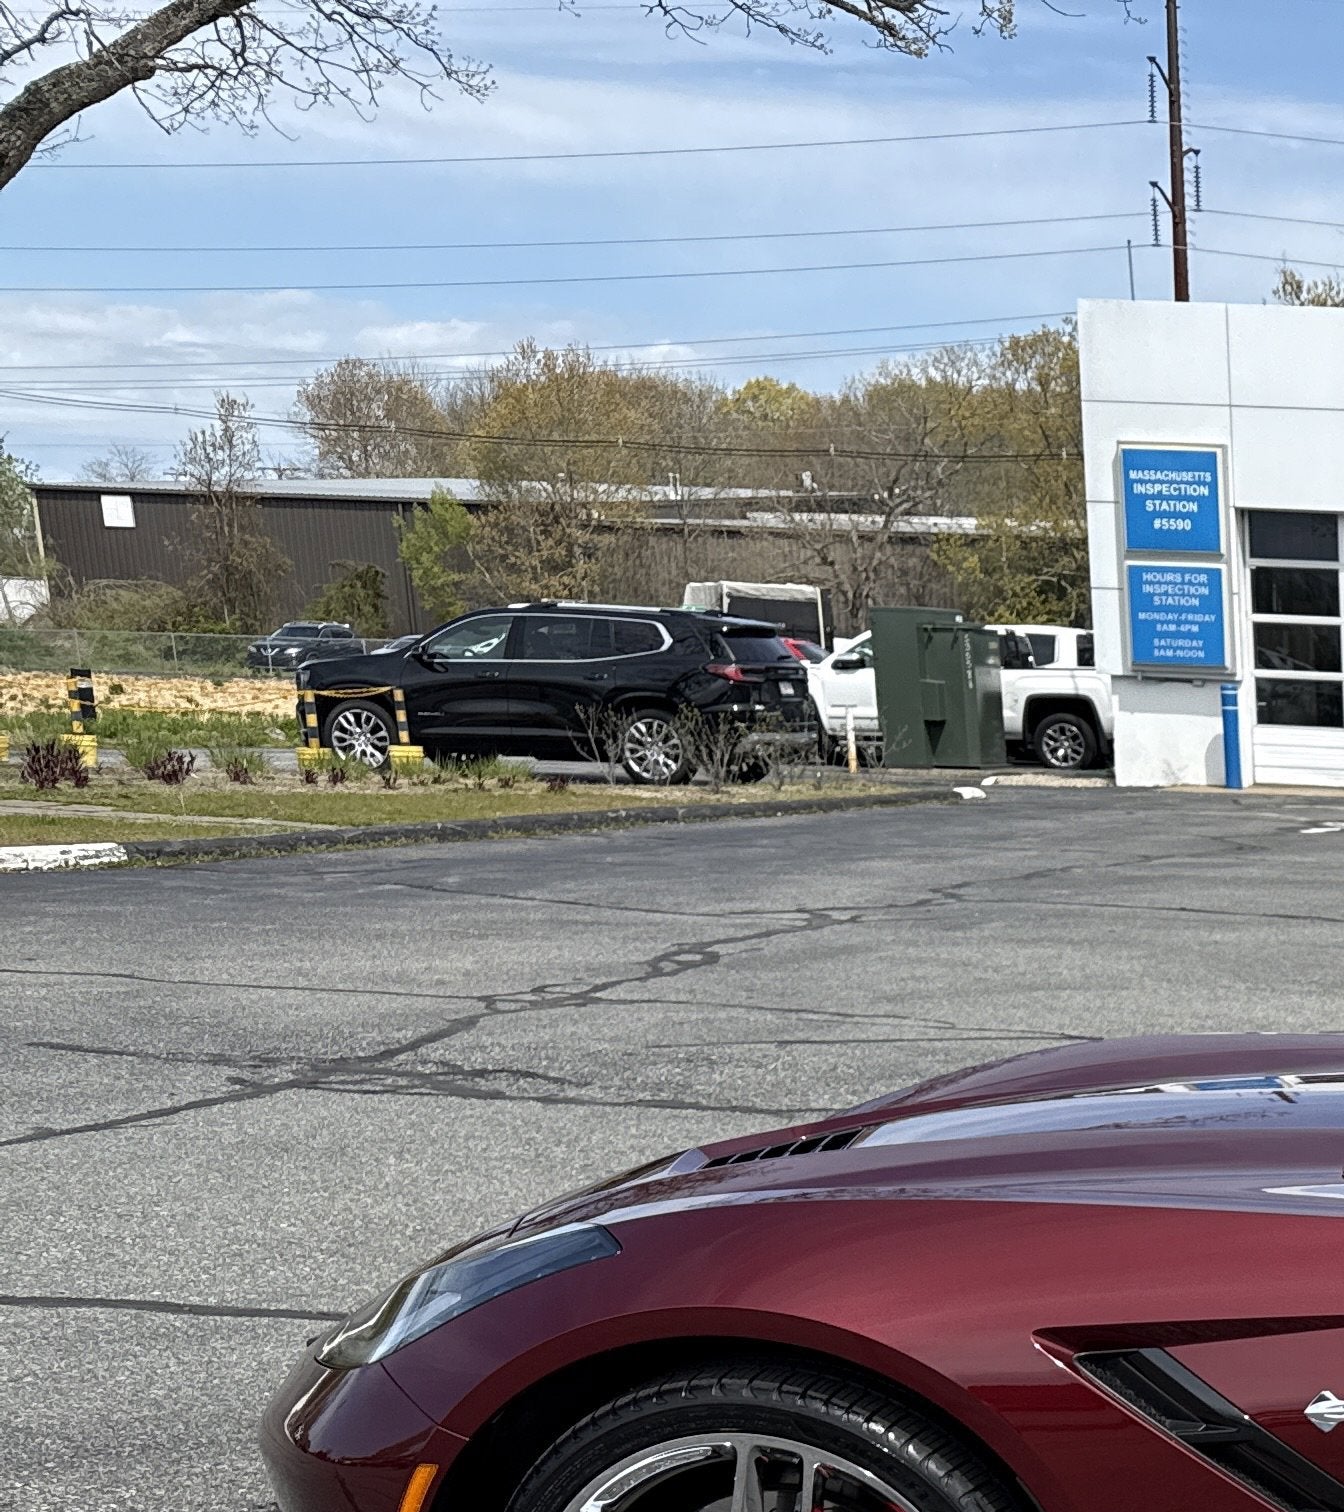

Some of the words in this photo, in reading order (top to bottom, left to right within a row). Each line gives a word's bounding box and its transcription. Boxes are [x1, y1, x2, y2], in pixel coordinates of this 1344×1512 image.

[1128, 469, 1212, 483] MASSACHUSETTS
[1132, 482, 1209, 497] INSPECTION
[1145, 499, 1198, 513] STATION
[1152, 517, 1192, 531] #5590
[1141, 571, 1182, 584] HOURS
[1184, 573, 1208, 584] FOR
[1141, 583, 1209, 596] INSPECTION
[1152, 595, 1200, 607] STATION
[1138, 611, 1216, 623] MONDAY-FRIDAY
[1153, 637, 1204, 648] SATURDAY
